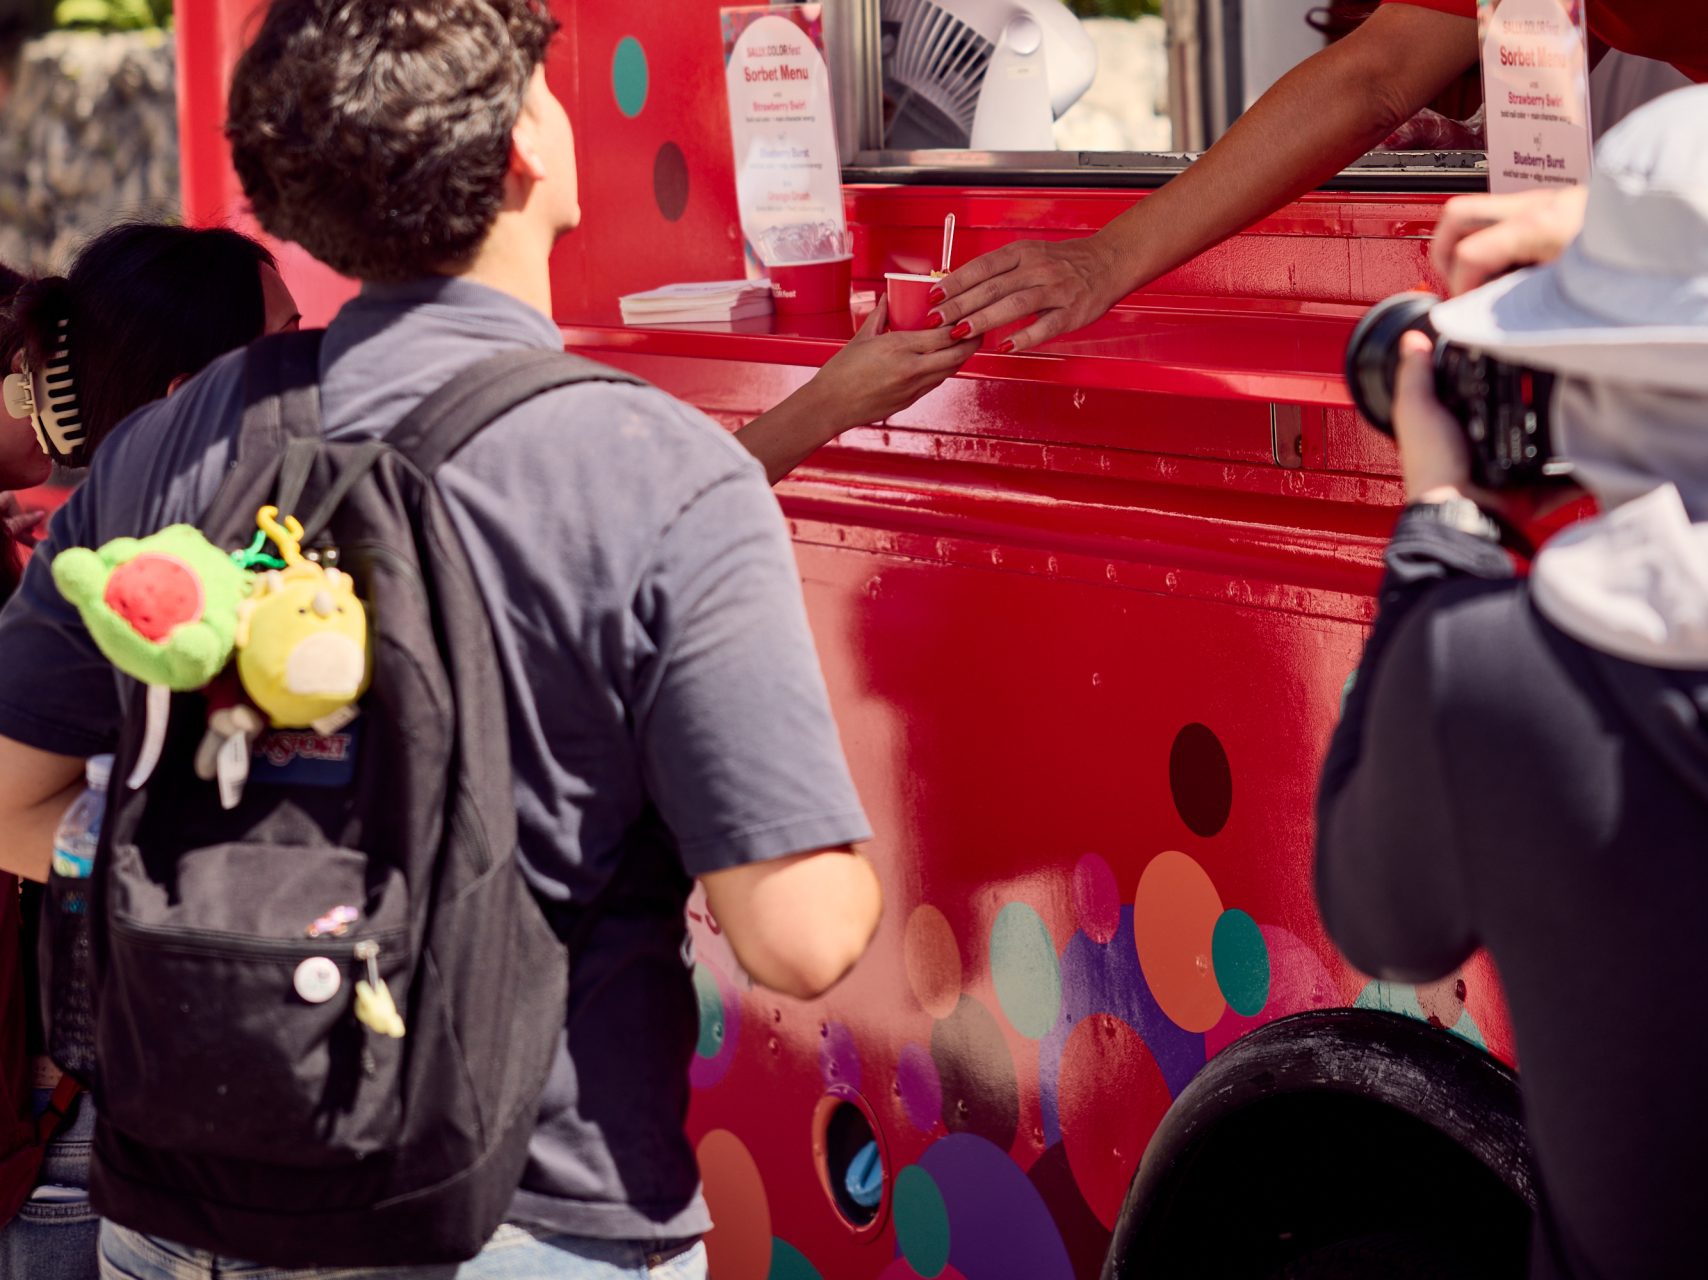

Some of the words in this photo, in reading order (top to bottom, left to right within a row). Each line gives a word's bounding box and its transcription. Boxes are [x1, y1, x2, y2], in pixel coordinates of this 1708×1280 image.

[1499, 45, 1536, 68] Sorbet
[744, 65, 779, 82] Sorbet
[780, 64, 809, 81] Menu
[1508, 91, 1545, 109] Strawberry
[1513, 150, 1545, 170] Blueberry
[1546, 154, 1565, 169] Burst
